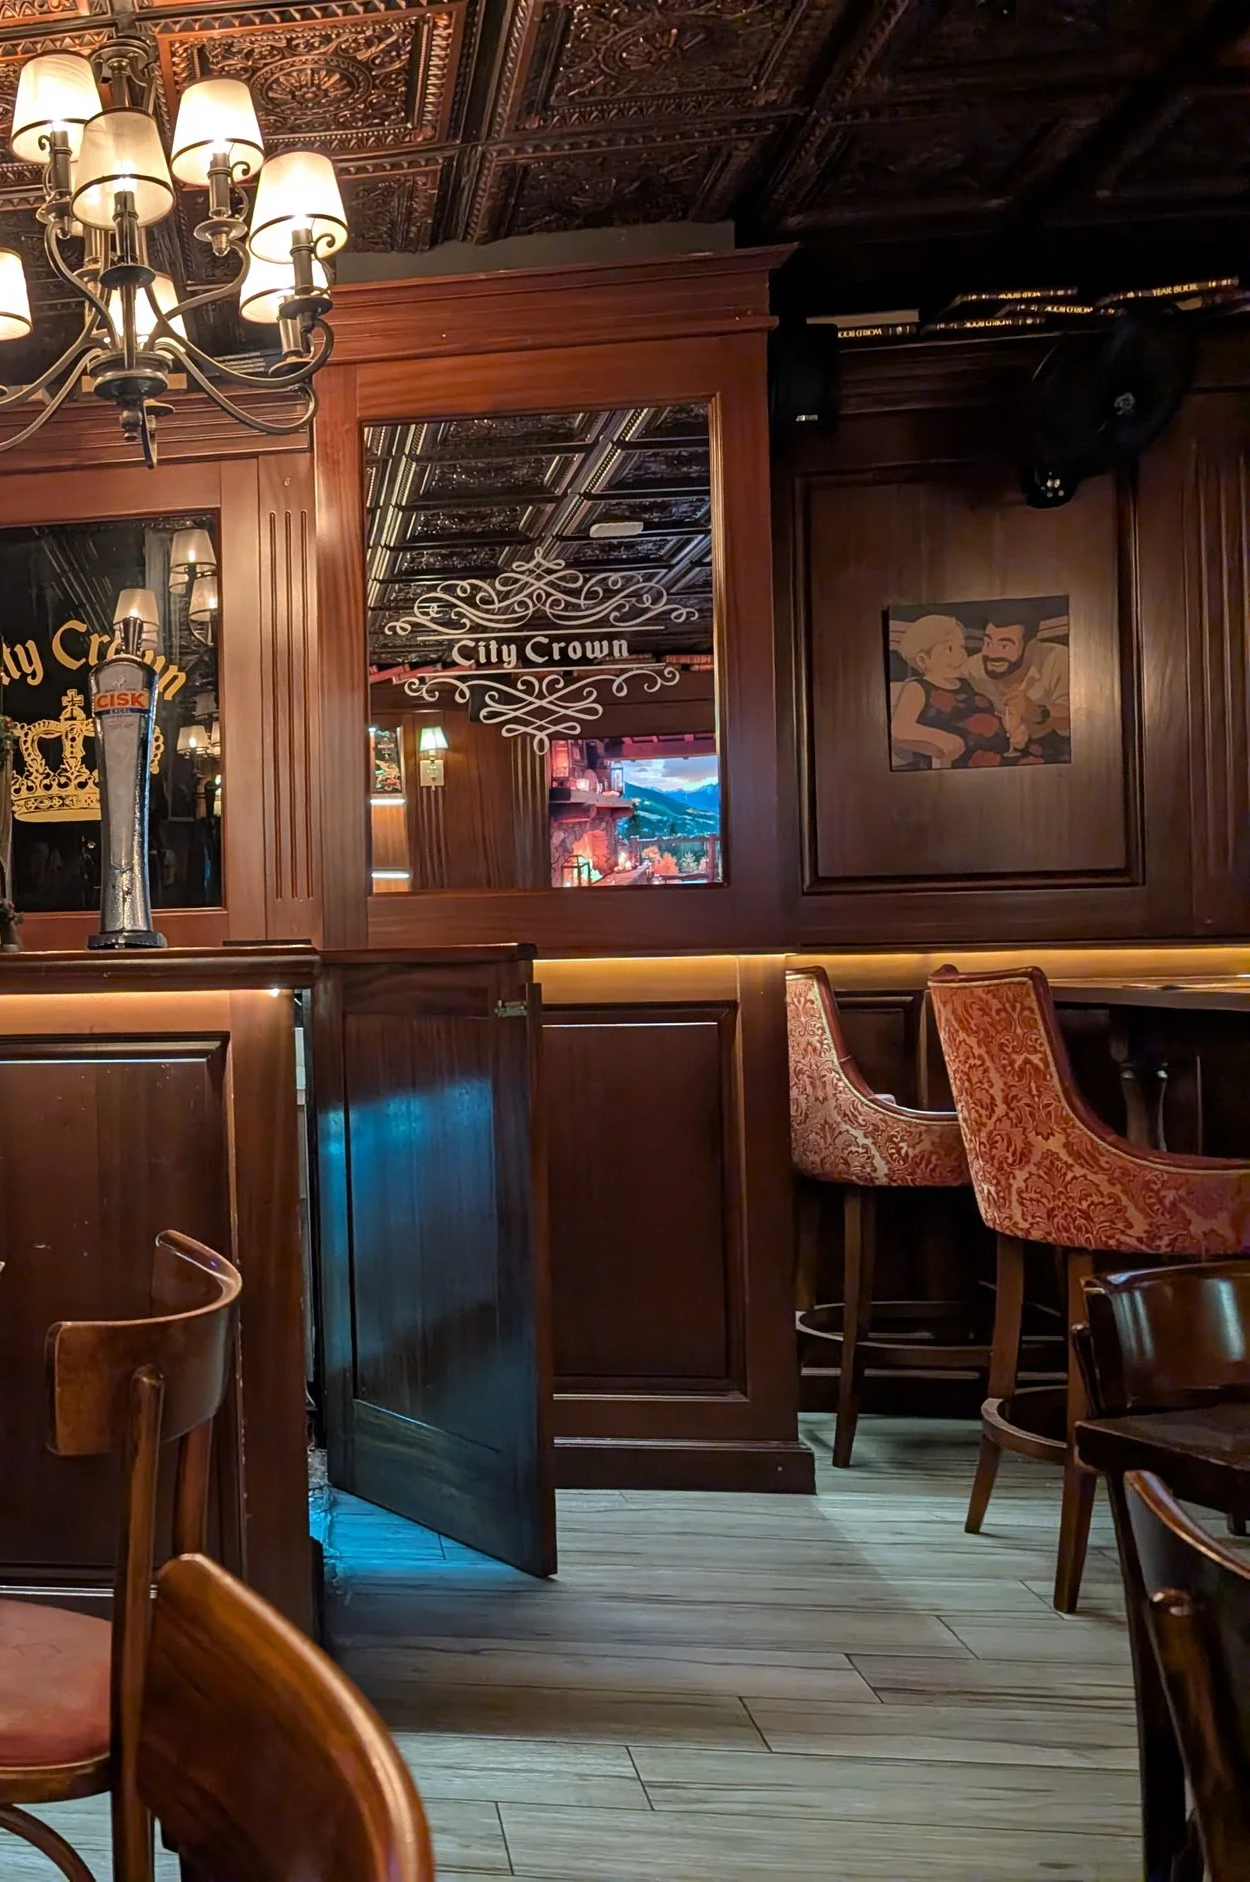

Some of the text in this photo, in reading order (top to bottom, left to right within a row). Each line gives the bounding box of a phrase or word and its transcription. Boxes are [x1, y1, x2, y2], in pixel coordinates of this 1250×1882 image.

[856, 328, 882, 336] WORLD
[52, 619, 187, 700] Crn
[452, 636, 630, 669] City Crown
[96, 692, 146, 709] CISK
